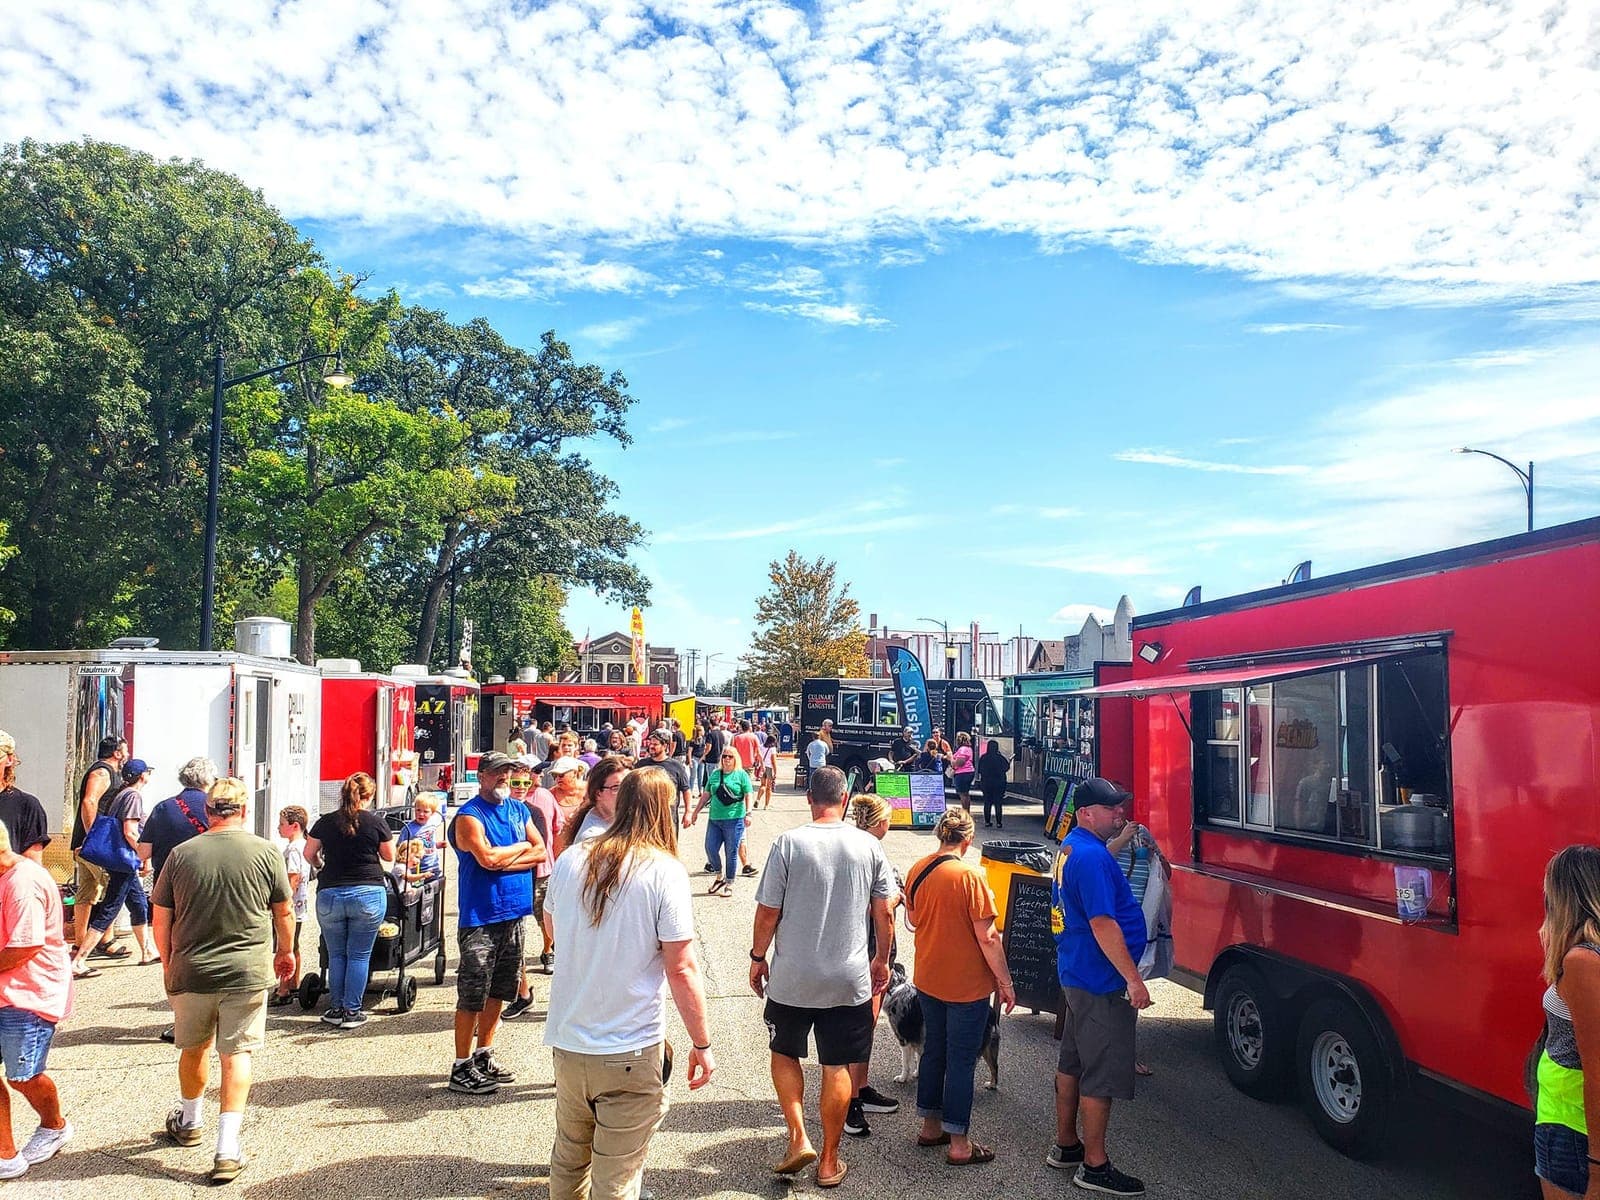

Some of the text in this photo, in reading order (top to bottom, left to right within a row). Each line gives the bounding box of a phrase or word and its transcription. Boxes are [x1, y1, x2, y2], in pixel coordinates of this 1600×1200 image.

[1045, 751, 1096, 779] Frozen Trea
[1018, 883, 1051, 897] WELCO
